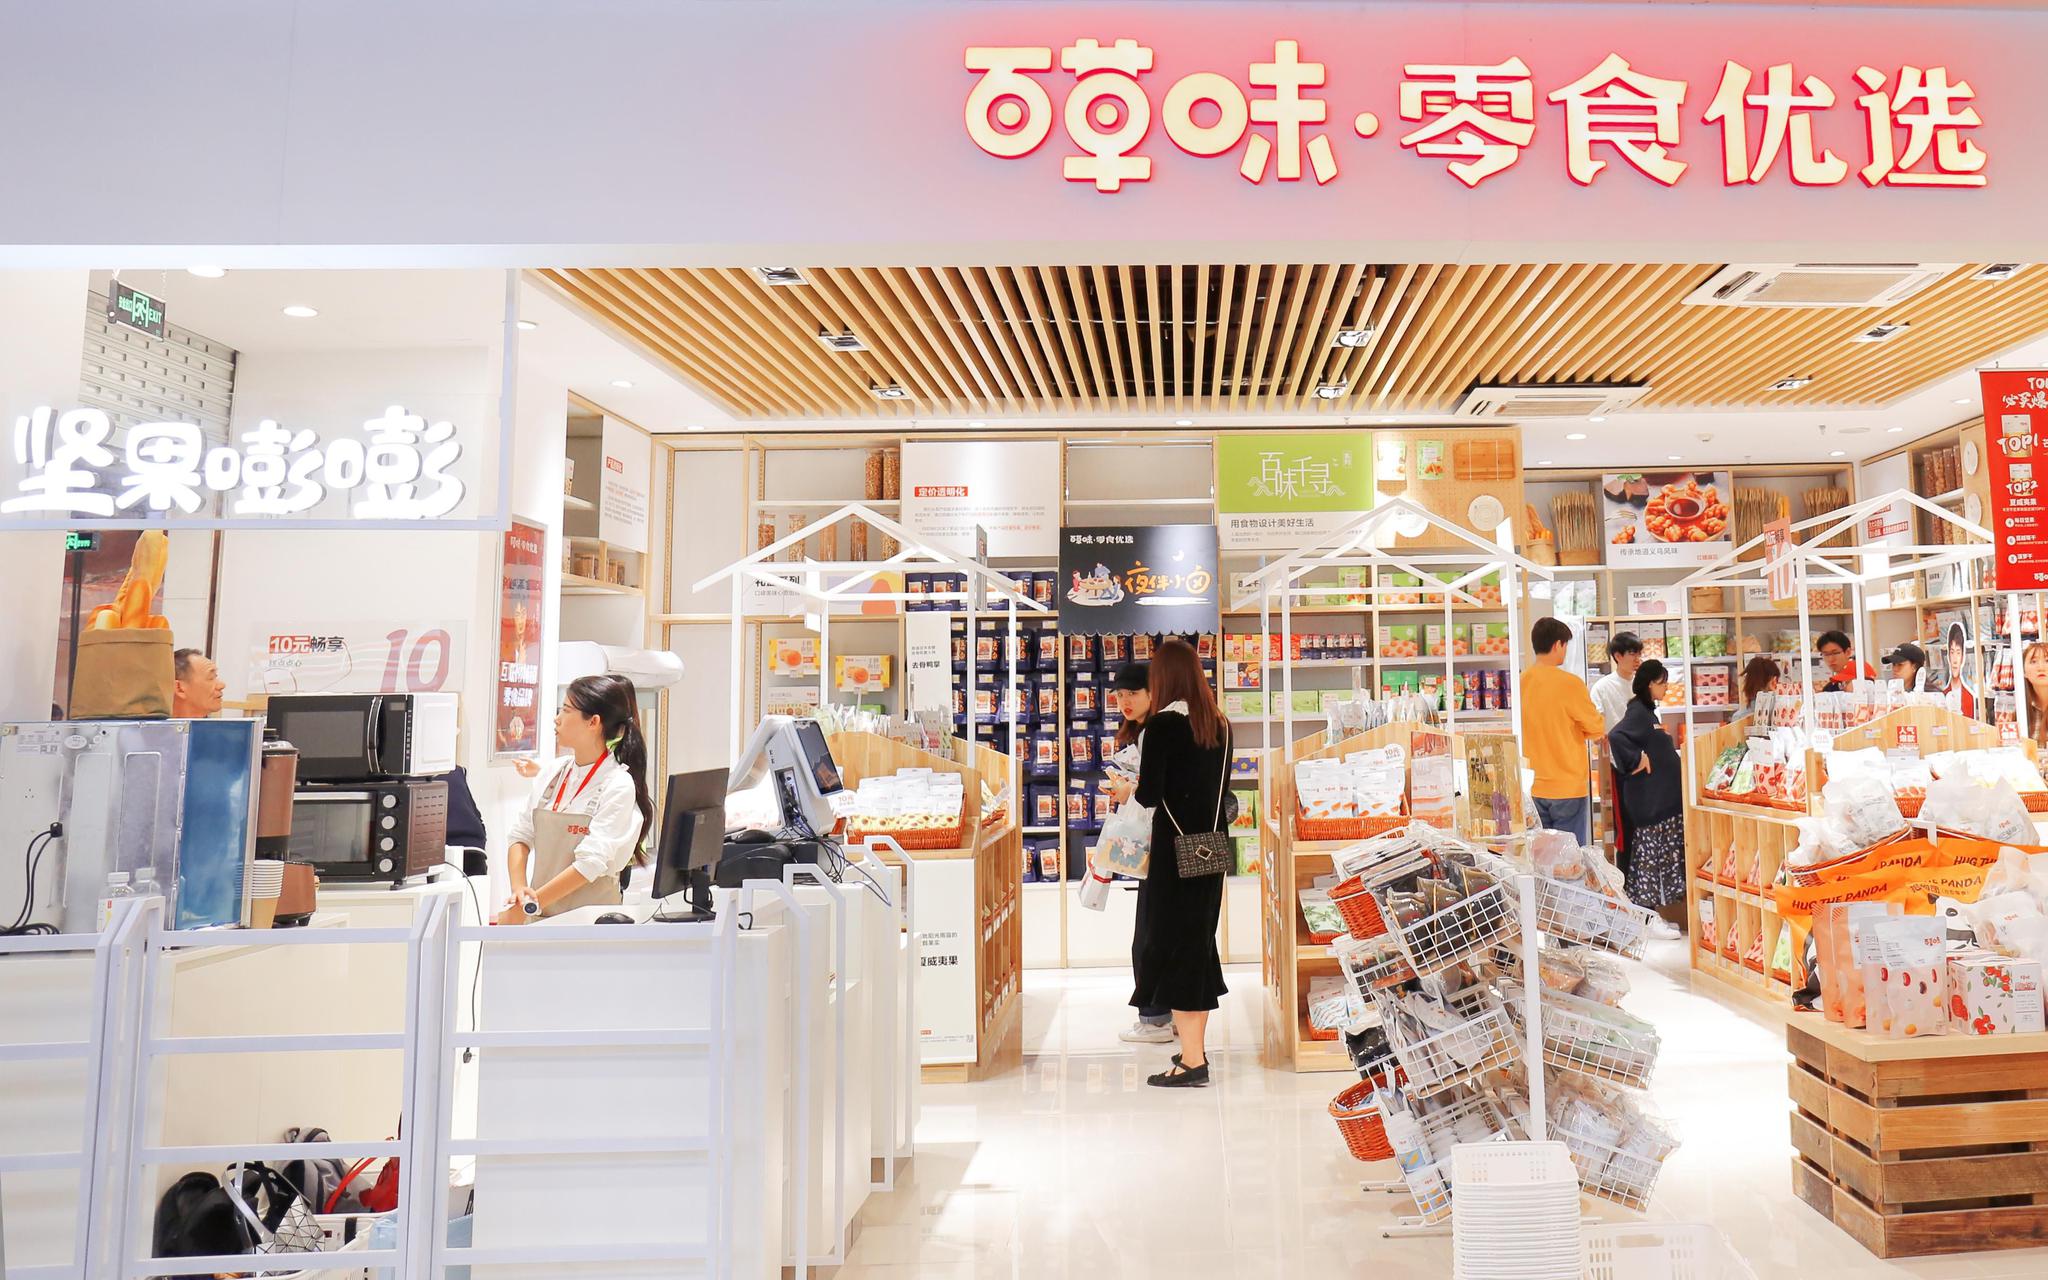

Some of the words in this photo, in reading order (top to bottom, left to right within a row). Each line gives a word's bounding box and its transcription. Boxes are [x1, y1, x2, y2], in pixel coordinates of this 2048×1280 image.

[964, 38, 1988, 192] 百草味·零食优选
[149, 308, 162, 324] EXIT
[1997, 433, 2039, 455] TOP1
[0, 405, 465, 520] 坚果嘭嘭
[918, 487, 965, 497] 定价透明化
[2006, 480, 2038, 495] TOP2
[1231, 518, 1314, 529] 用食物设计美好生活
[1124, 560, 1212, 595] 夜伴小卤
[270, 635, 345, 653] 10元畅享
[379, 628, 451, 693] 10
[912, 661, 940, 669] 去骨鸭掌
[568, 824, 591, 836] 百草味
[1941, 876, 1982, 888] PANDA
[1845, 883, 1887, 902] PANDA
